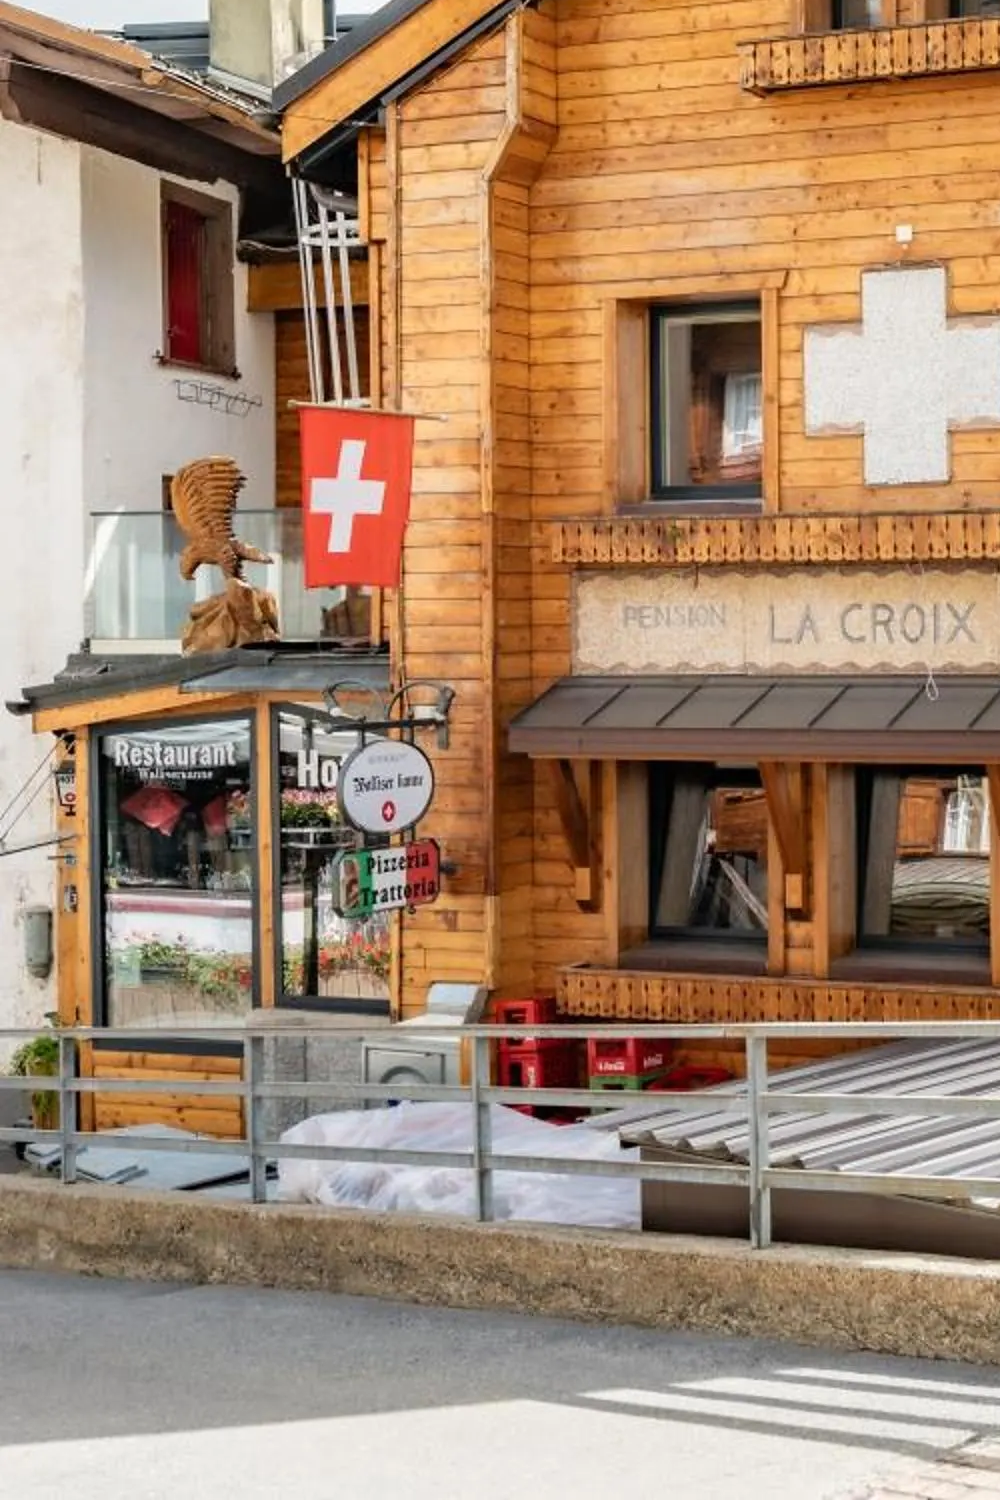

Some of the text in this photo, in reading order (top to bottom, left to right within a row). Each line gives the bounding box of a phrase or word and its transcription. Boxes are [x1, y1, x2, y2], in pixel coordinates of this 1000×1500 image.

[621, 604, 726, 629] PENSION
[768, 603, 819, 645] LA
[840, 602, 977, 645] CROIX
[114, 740, 237, 767] Restaurant
[297, 749, 341, 788] Ho
[366, 850, 430, 877] Pizzeria
[361, 879, 437, 907] Trattoria
